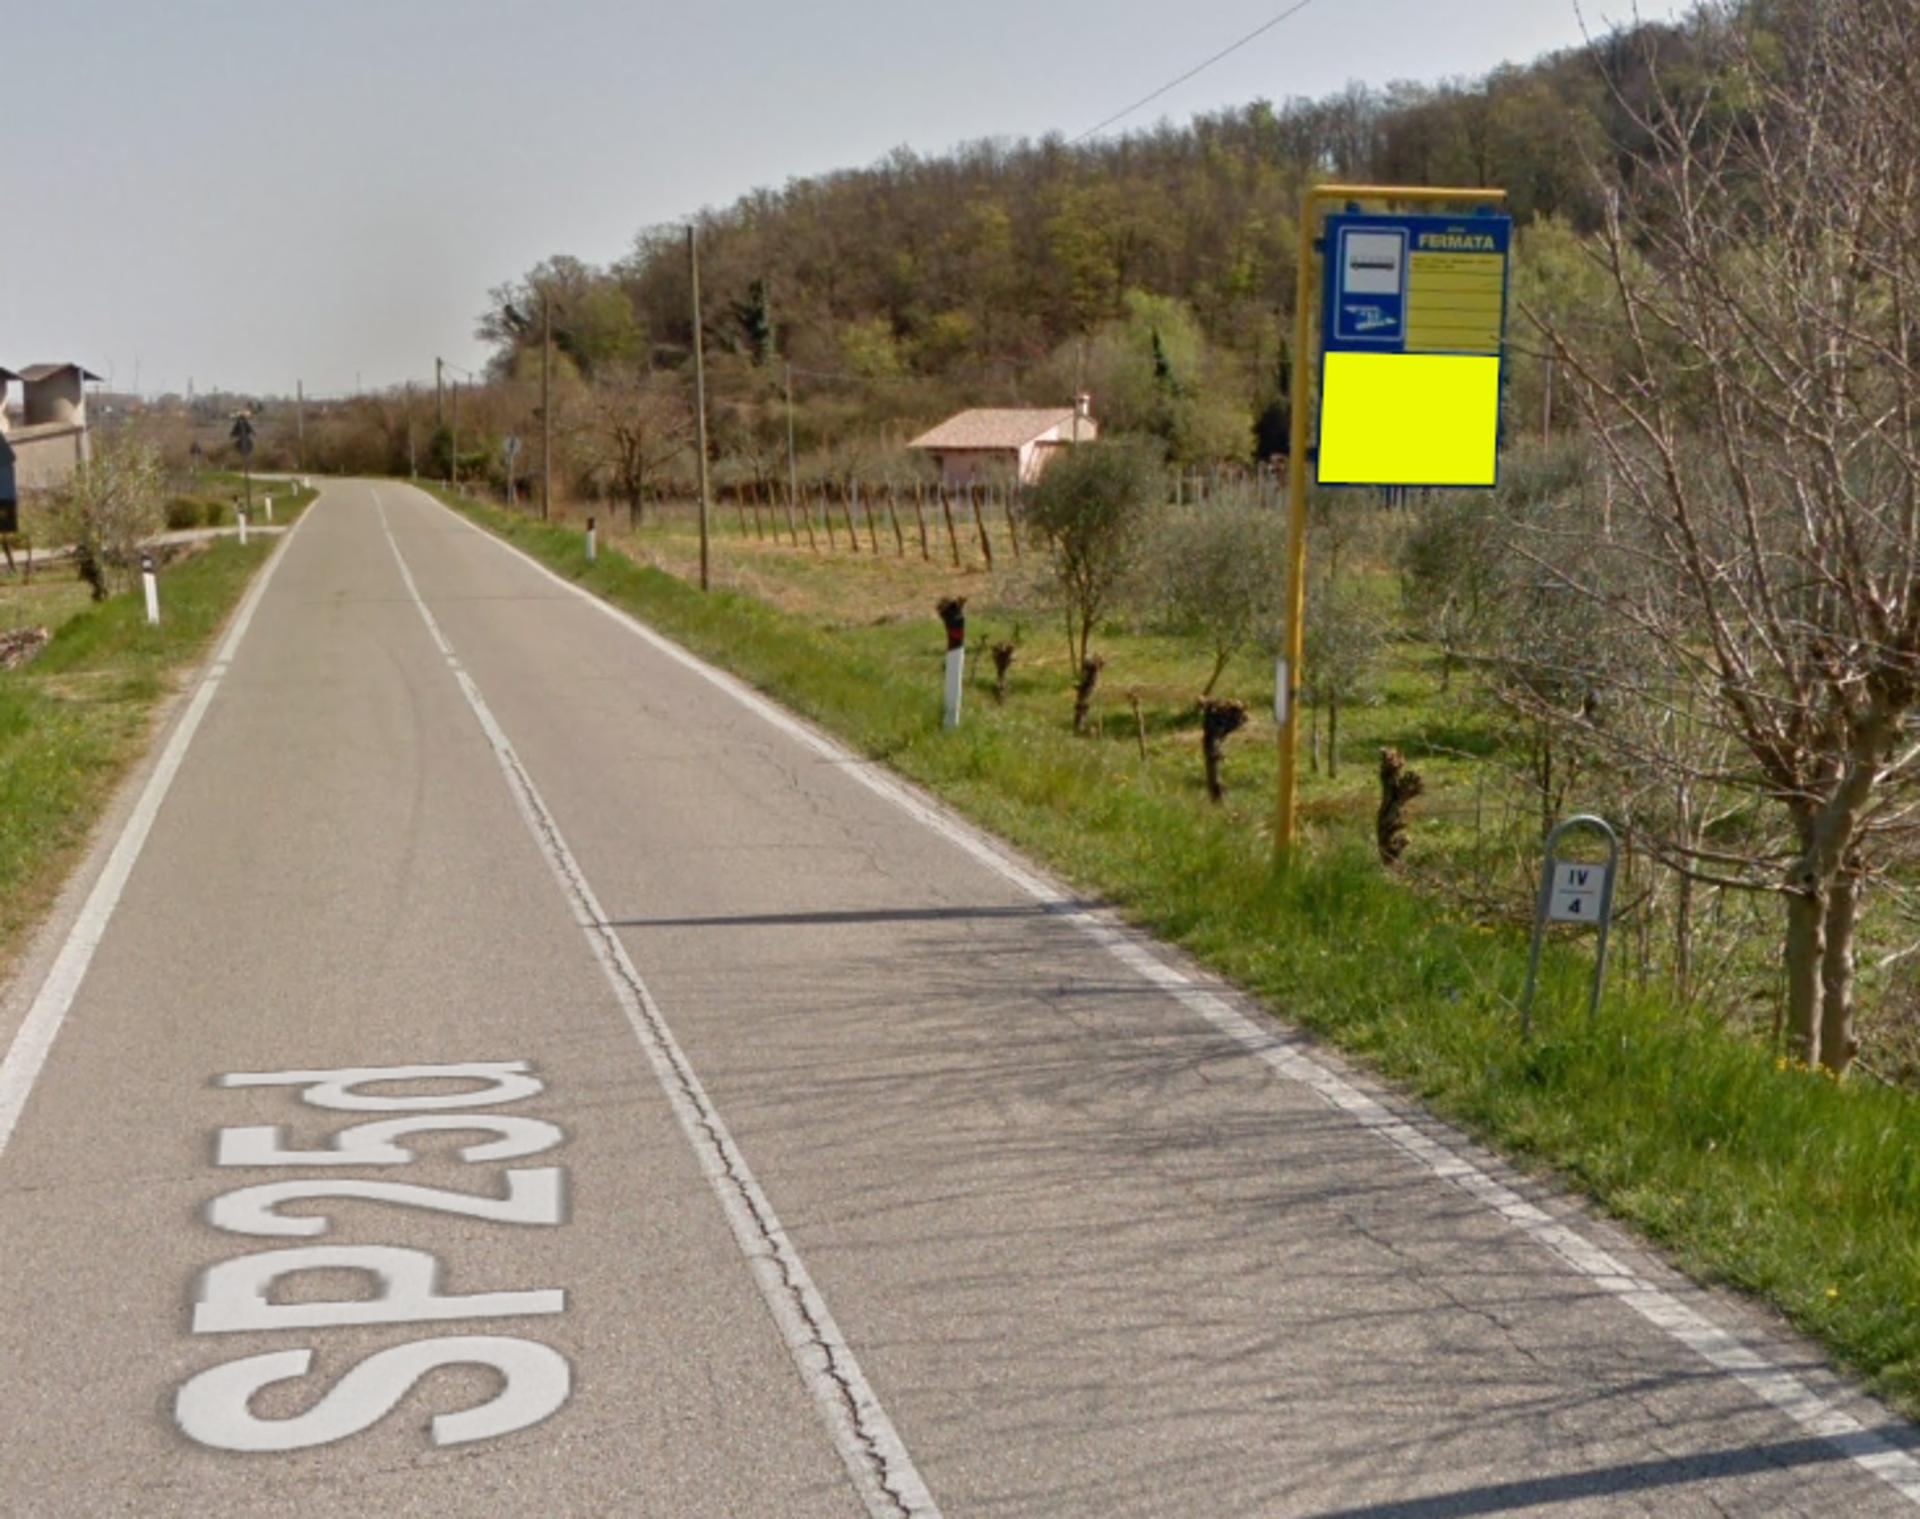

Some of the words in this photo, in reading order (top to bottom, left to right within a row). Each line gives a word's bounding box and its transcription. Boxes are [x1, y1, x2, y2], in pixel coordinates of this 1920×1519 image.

[1419, 233, 1495, 250] FERMATA
[1569, 869, 1589, 886] IV
[1568, 898, 1581, 914] 4
